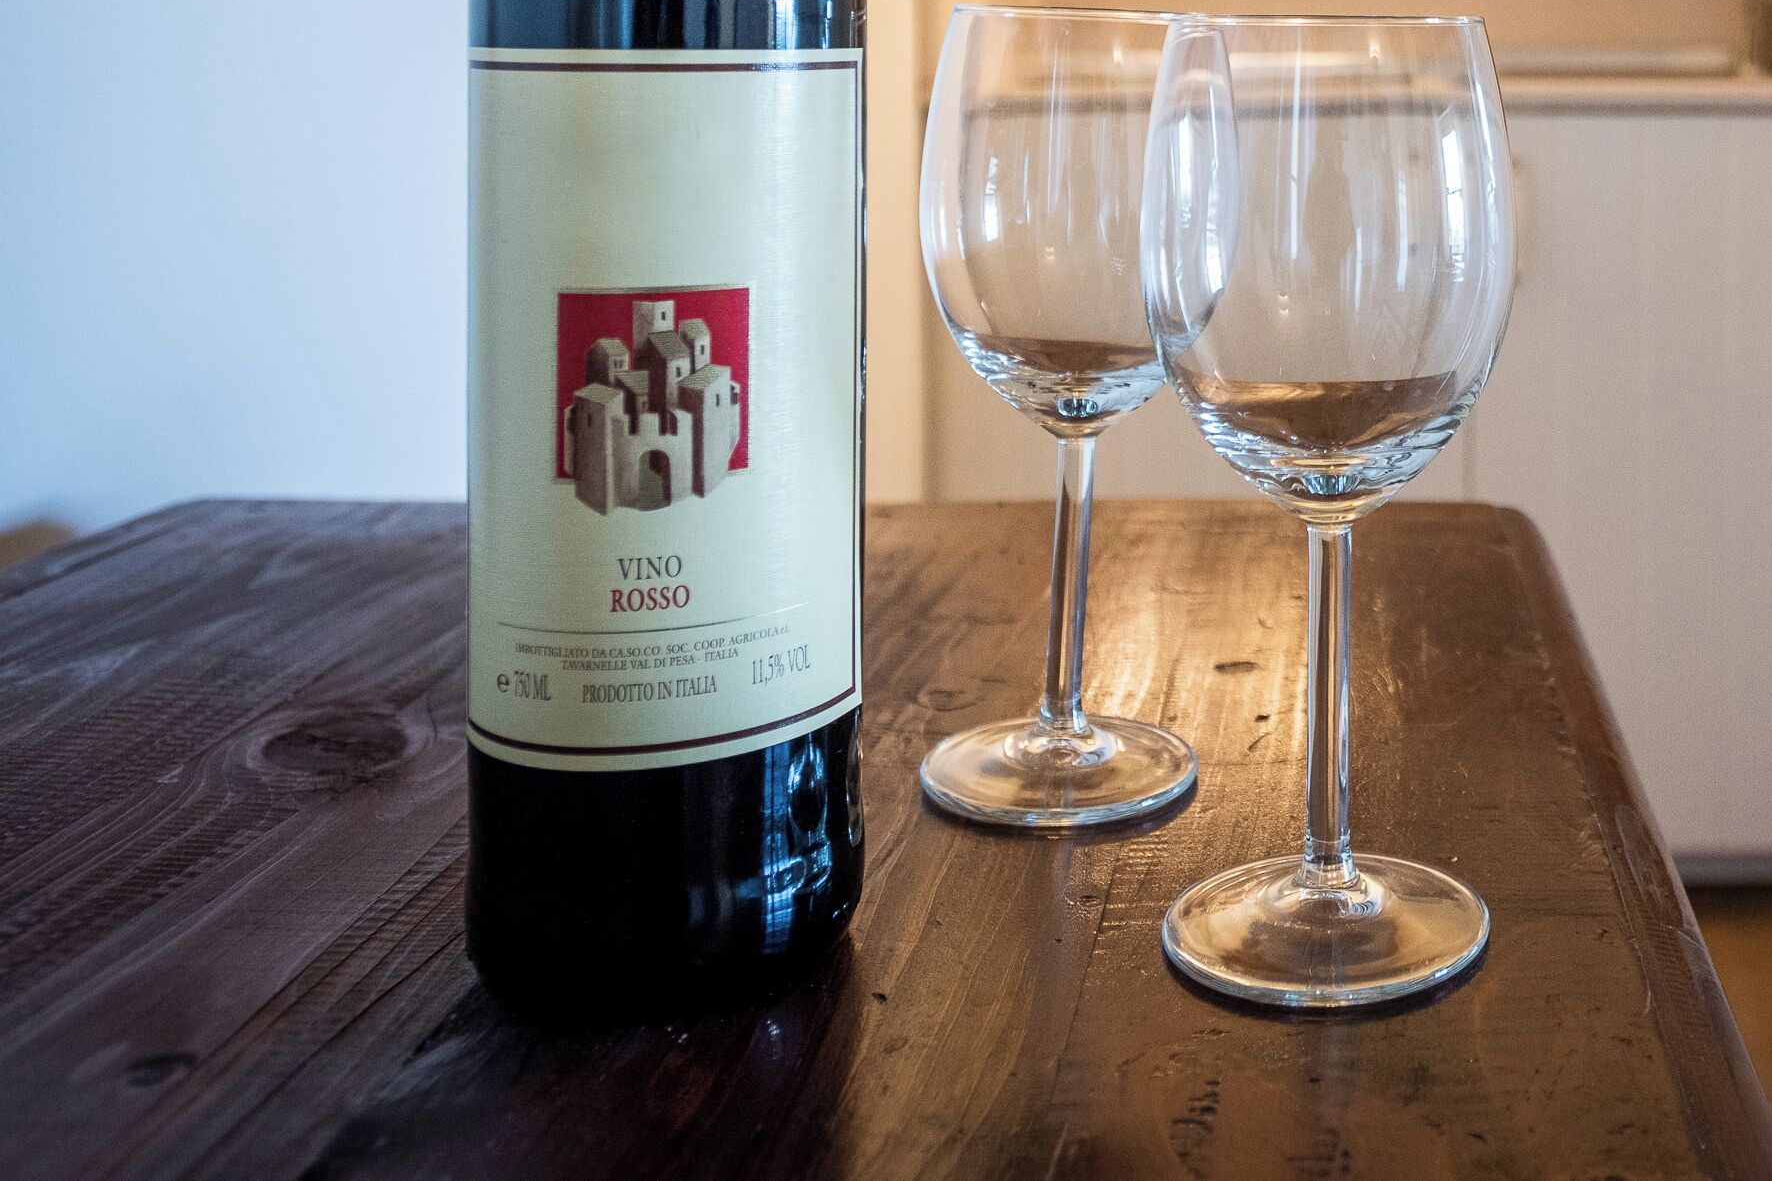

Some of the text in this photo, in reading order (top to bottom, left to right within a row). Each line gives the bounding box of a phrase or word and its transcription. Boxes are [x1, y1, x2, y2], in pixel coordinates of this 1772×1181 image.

[618, 555, 683, 581] VINO
[609, 584, 691, 613] ROSSO
[515, 642, 589, 658] IMBOTTIGLIATO
[666, 642, 691, 655] SOC.
[694, 638, 726, 652] COOP.
[728, 626, 779, 647] AGRICOLA
[562, 659, 628, 671] TAVARNELLE
[629, 659, 651, 671] VAL
[653, 658, 667, 669] DI
[669, 655, 695, 668] PESA
[704, 647, 739, 663] ITALIA
[751, 643, 811, 686] 11,5% VOL
[513, 670, 530, 700] 750
[532, 673, 551, 701] ML
[582, 674, 718, 704] PRODOTTO IN ITALIA
